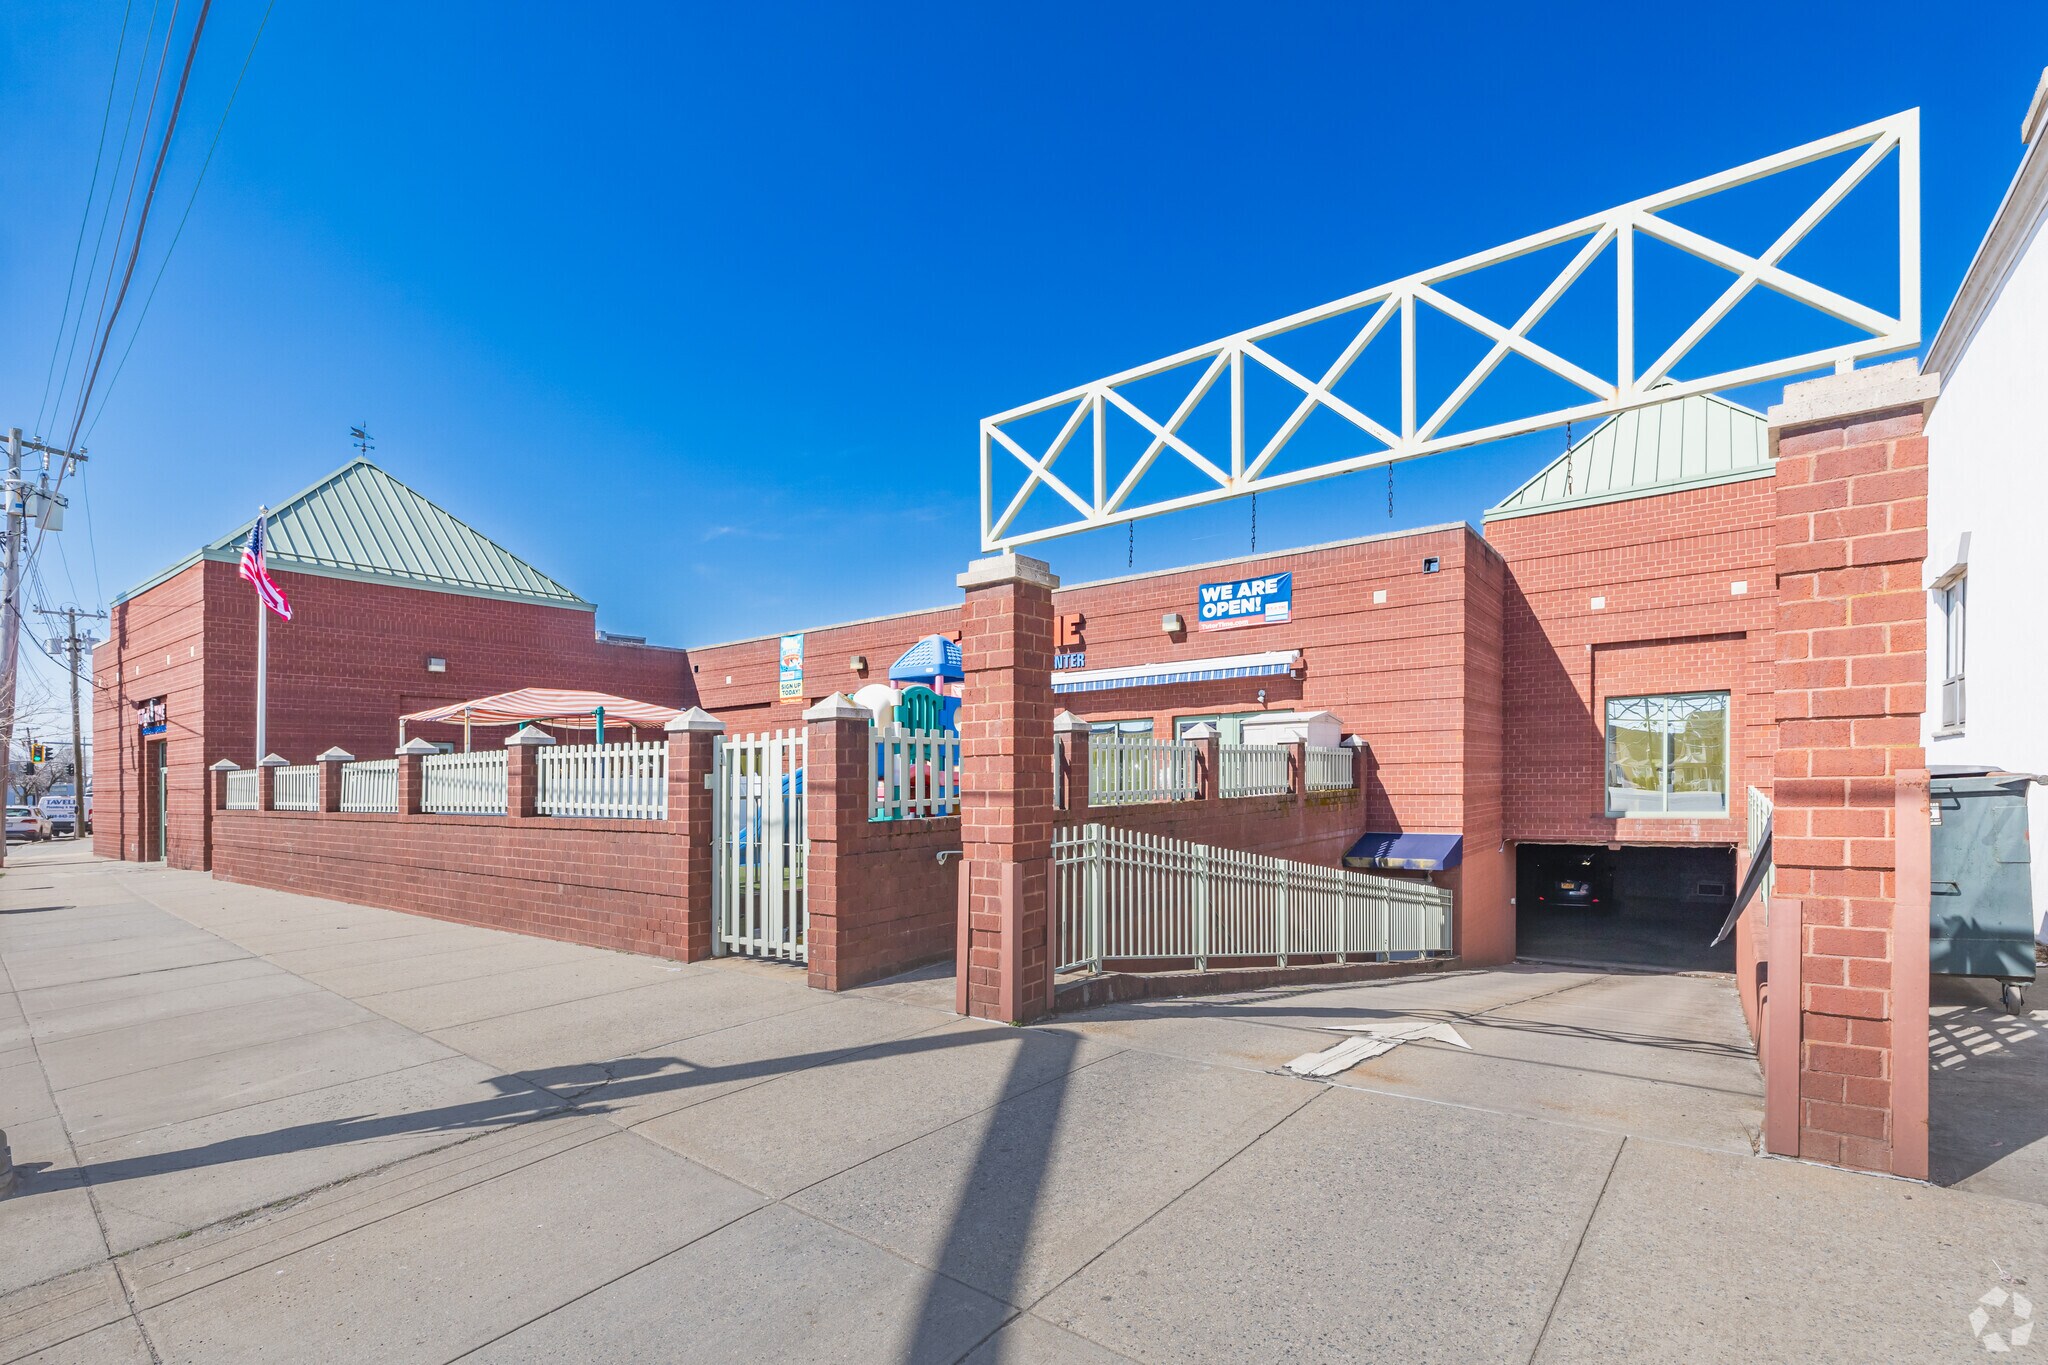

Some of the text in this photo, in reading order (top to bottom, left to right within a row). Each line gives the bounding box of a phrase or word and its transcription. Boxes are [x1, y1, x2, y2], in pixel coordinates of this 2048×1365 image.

[1202, 579, 1278, 602] WE ARE
[1202, 597, 1262, 618] OPEN!
[1201, 620, 1249, 630] TutorTime.com
